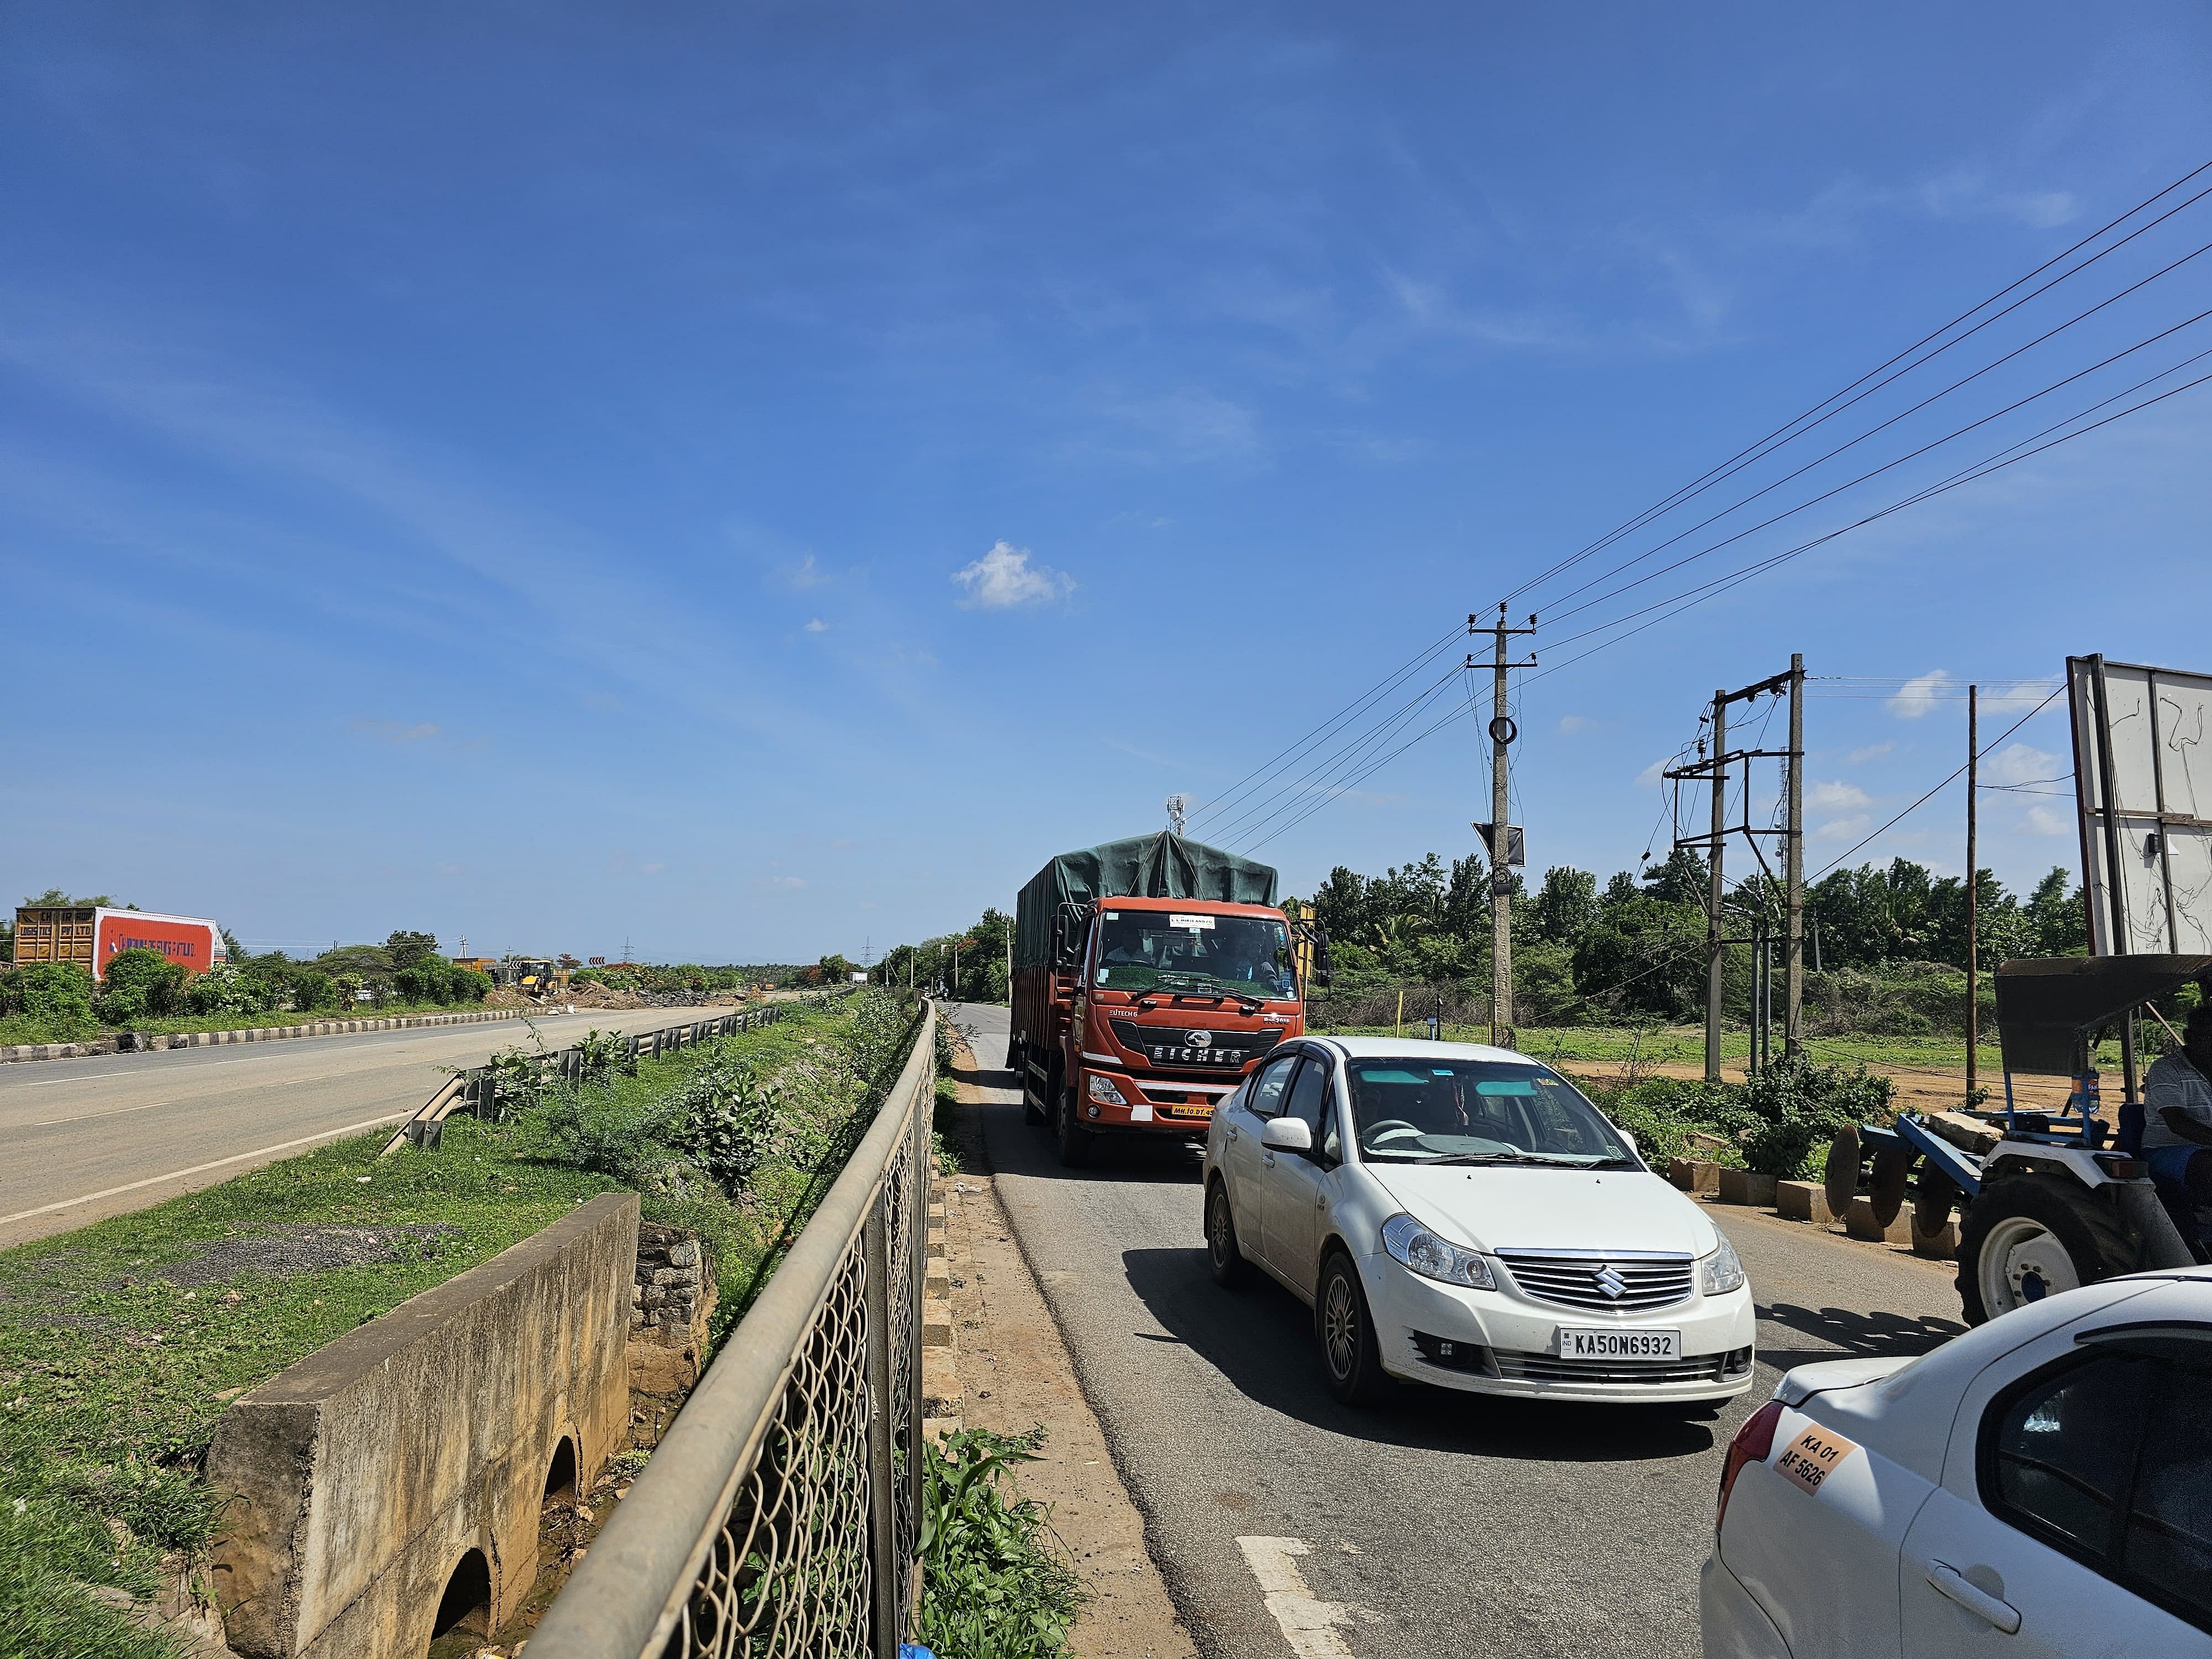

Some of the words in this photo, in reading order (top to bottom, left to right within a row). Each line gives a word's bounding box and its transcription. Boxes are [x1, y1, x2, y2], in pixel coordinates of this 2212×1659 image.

[1154, 1047, 1241, 1063] EICHER
[1575, 1334, 1672, 1355] KA50N6932
[1800, 1434, 1823, 1454] KA
[1819, 1446, 1840, 1463] 01
[1779, 1450, 1801, 1468] AF
[1794, 1458, 1825, 1486] 5626
